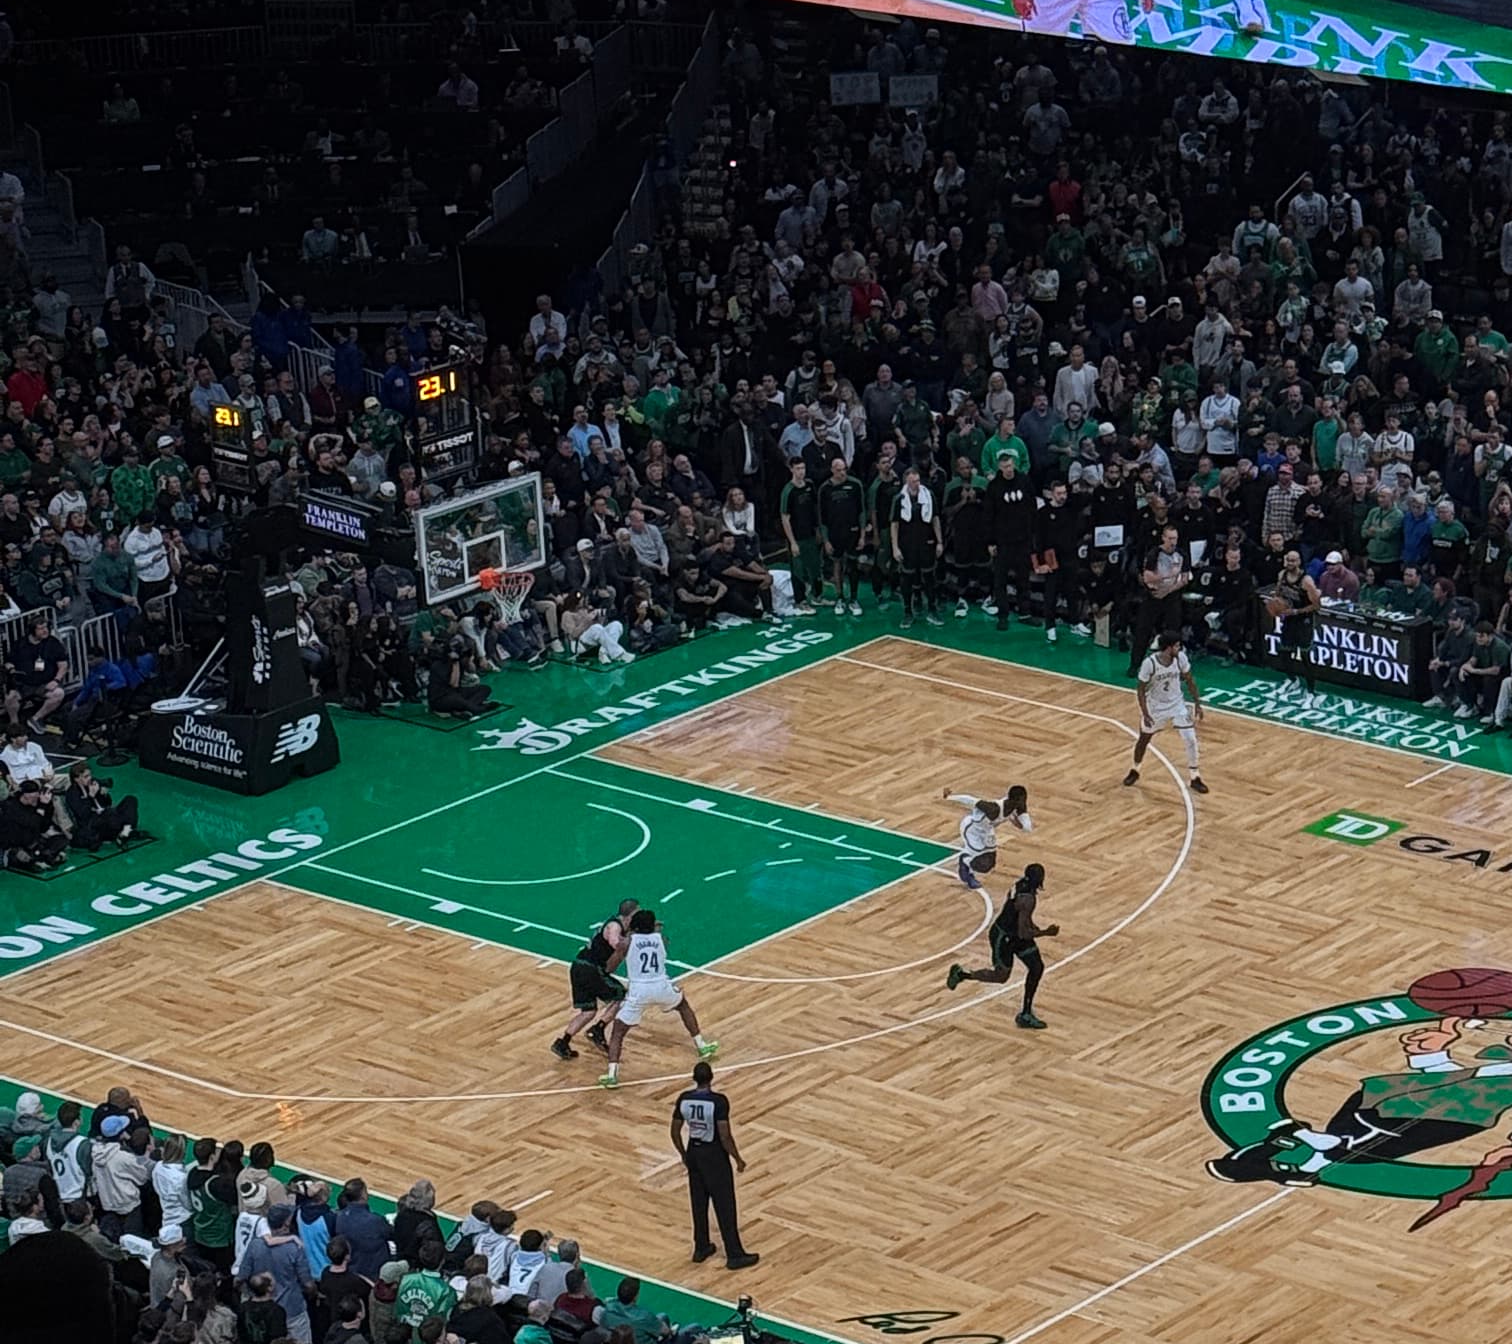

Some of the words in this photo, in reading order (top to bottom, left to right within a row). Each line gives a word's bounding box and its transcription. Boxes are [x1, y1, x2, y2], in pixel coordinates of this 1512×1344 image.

[418, 371, 455, 401] 23.1
[304, 512, 366, 540] TEMPLETON
[307, 503, 361, 528] FRANKLIN
[519, 629, 834, 755] DRAFTKINGS
[184, 715, 228, 743] Boston
[1200, 686, 1480, 758] TEMPLETON
[171, 725, 243, 764] Scientific
[1324, 814, 1390, 841] TD
[90, 826, 324, 917] CELTICS
[639, 952, 660, 974] 24
[1219, 1000, 1407, 1113] BOSTON
[400, 1288, 435, 1311] CELTICS
